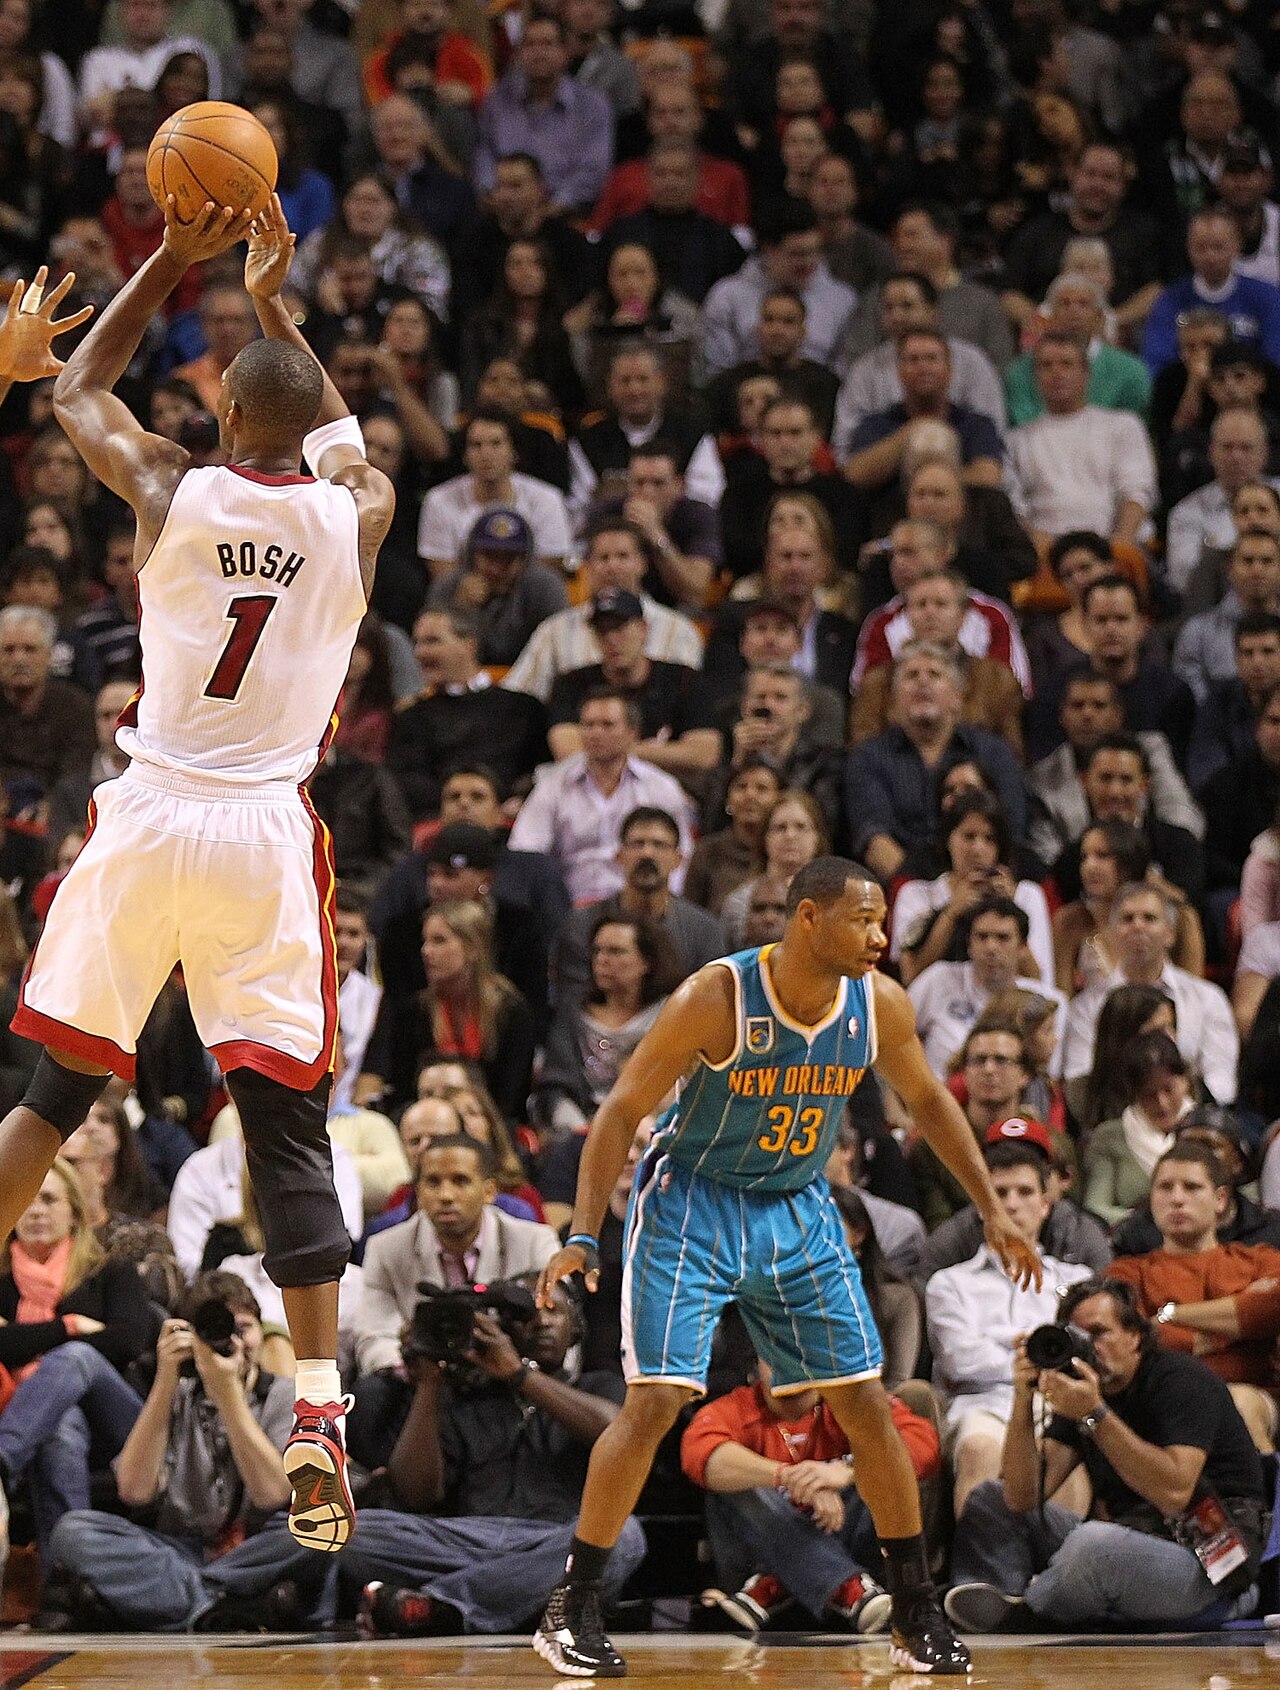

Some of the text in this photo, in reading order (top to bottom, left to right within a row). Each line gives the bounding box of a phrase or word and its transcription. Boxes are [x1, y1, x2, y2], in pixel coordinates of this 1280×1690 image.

[216, 541, 306, 588] BOSH
[202, 593, 280, 702] 1
[729, 1065, 865, 1097] NEW ORLEAN
[757, 1105, 824, 1156] 33
